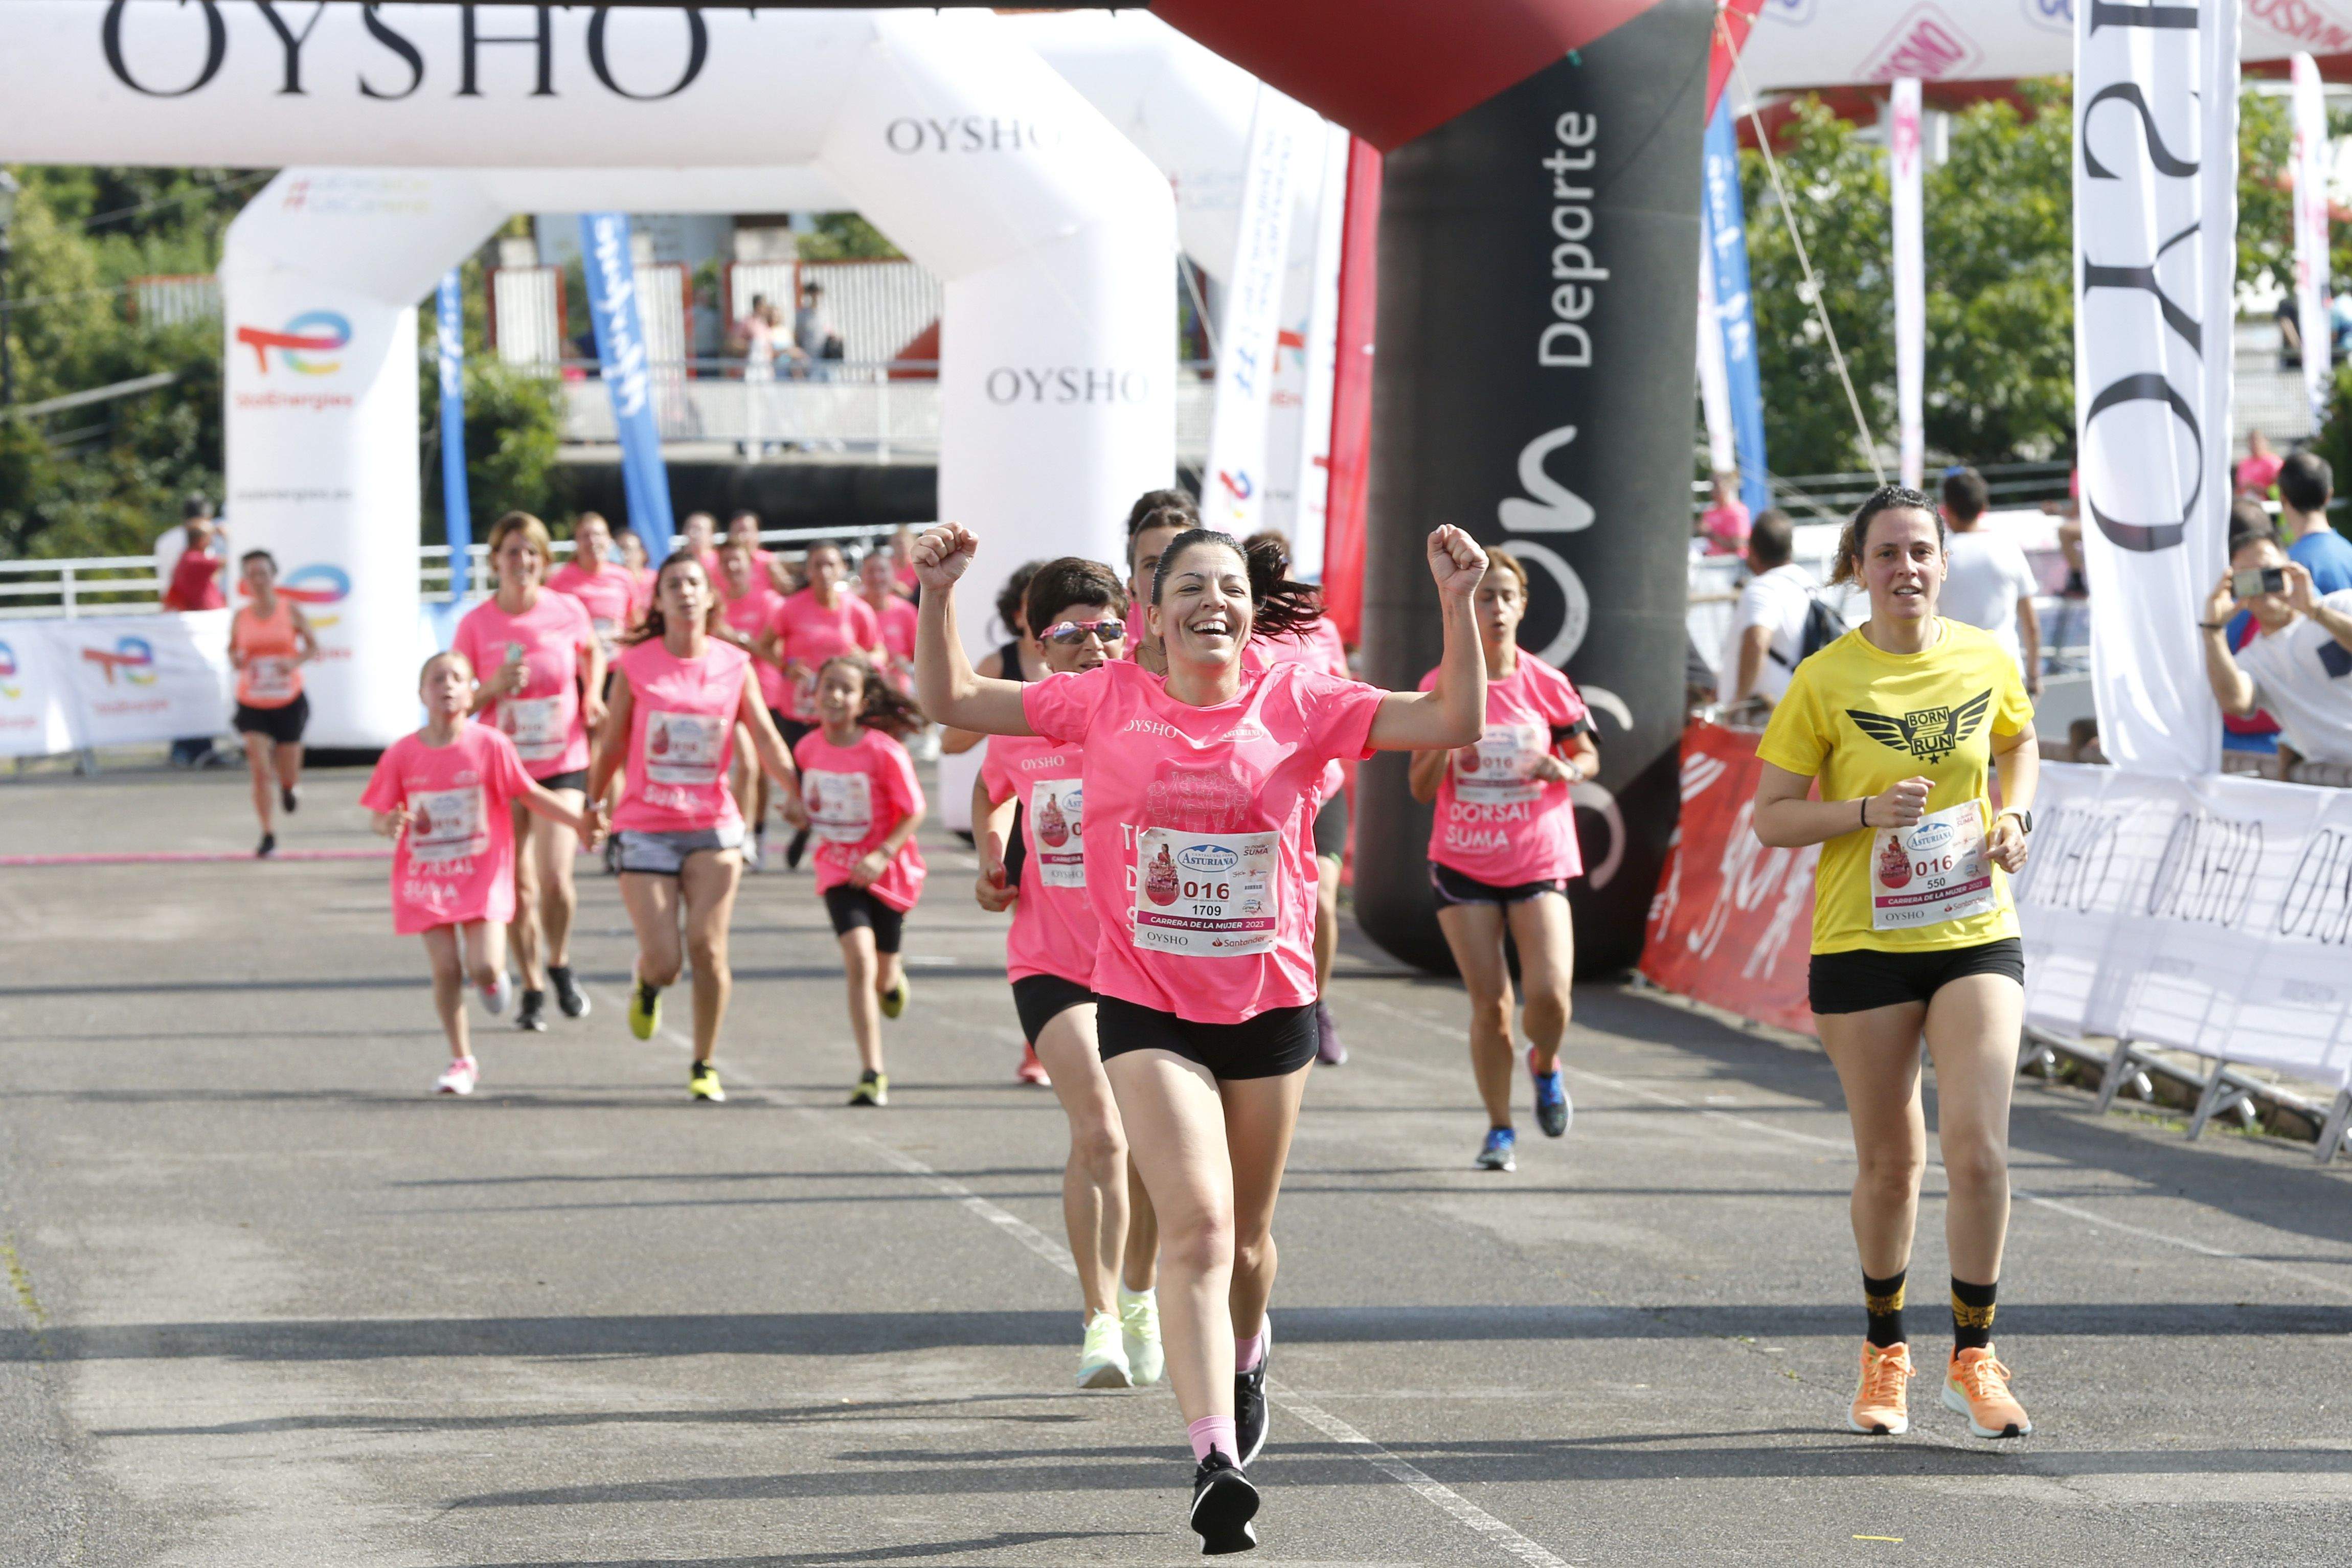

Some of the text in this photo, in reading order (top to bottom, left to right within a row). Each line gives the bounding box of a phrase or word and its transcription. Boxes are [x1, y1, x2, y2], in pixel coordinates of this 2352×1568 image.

[102, 1, 707, 101] OYSHO
[1538, 111, 1610, 367] Deporte
[986, 366, 1149, 405] OYSHO
[1909, 710, 1948, 726] BORN
[1913, 735, 1953, 752] RUN
[1022, 755, 1066, 771] OYSHO
[1444, 824, 1509, 847] SUMA
[1911, 831, 1952, 848] ASTURIANA
[1182, 853, 1234, 866] ASTURIANA
[1243, 848, 1269, 856] SUMA
[1915, 855, 1953, 876] 016
[2147, 812, 2264, 928] OYSHO
[1184, 881, 1230, 900] 016
[1927, 877, 1946, 889] 550
[1888, 896, 1924, 905] CARRERA
[1944, 885, 1967, 897] MUJER
[1192, 904, 1222, 916] 1709
[1886, 896, 1987, 921] OYSHO Santander
[1150, 916, 1188, 927] CARRERA
[1147, 931, 1265, 947] OYSHO Santander
